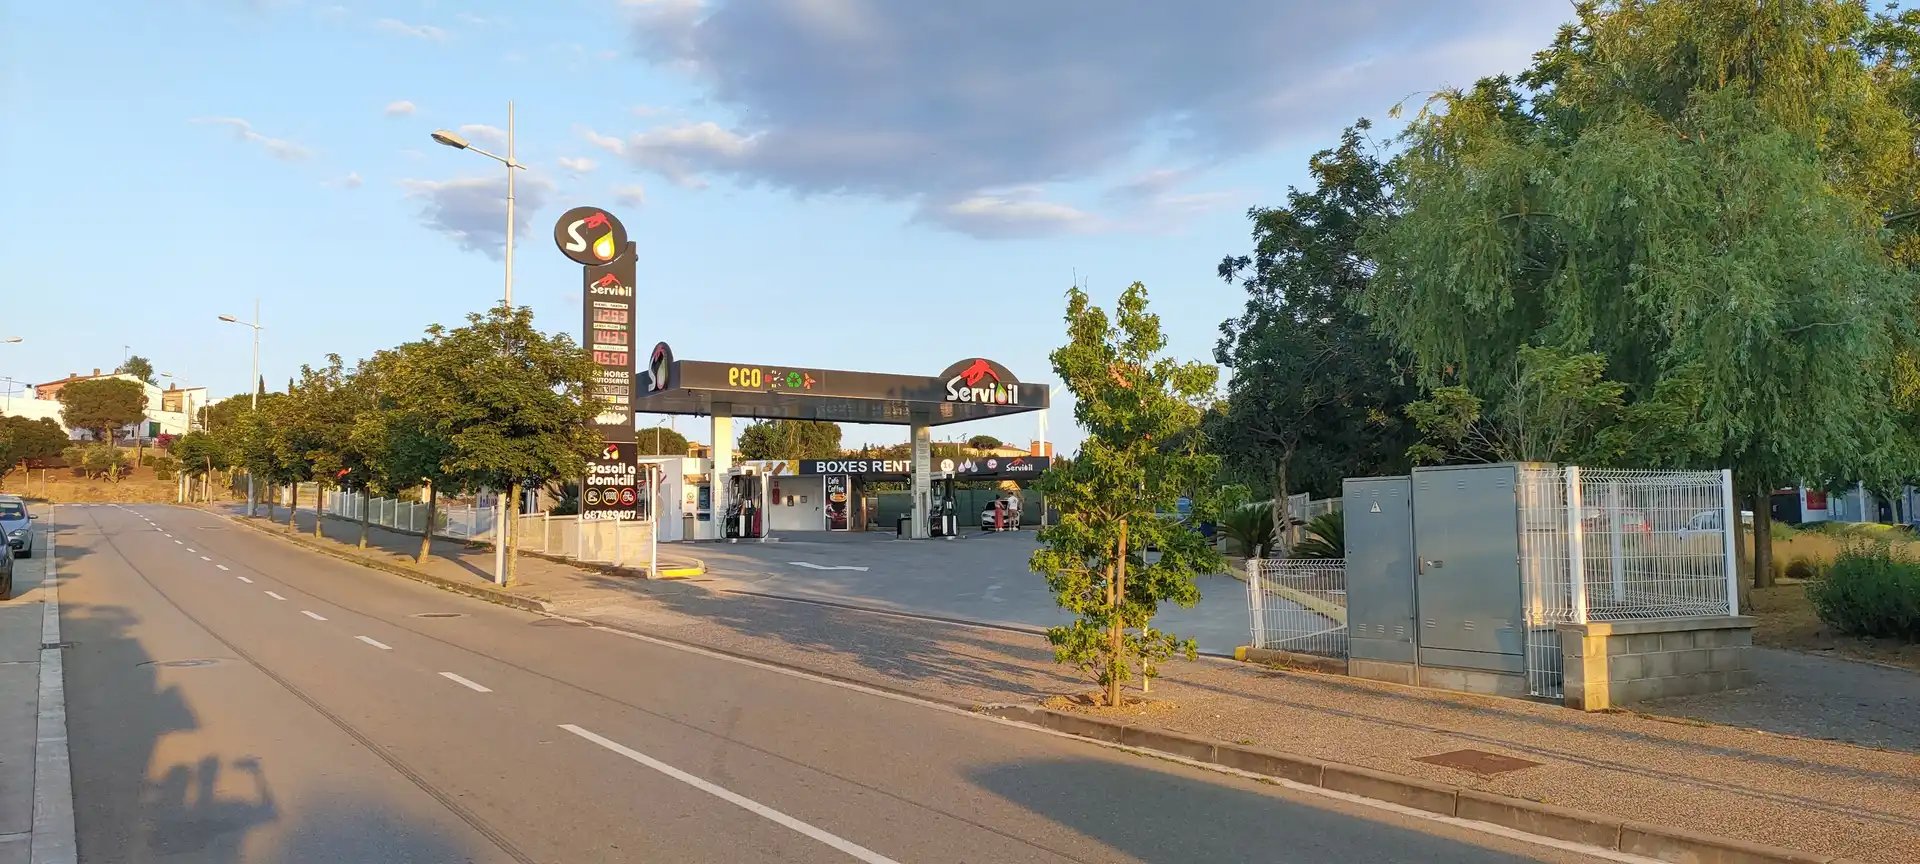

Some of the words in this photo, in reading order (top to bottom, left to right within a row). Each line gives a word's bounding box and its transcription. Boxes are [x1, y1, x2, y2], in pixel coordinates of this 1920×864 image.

[590, 280, 632, 297] Servioil
[603, 370, 629, 378] HORES
[728, 367, 761, 388] eco
[946, 375, 1018, 405] Servioil
[587, 462, 626, 474] Gasoil
[627, 465, 636, 474] a
[816, 461, 867, 473] BOXES
[872, 460, 912, 472] RENT
[587, 474, 634, 486] domicili
[584, 510, 636, 520] 687429407
